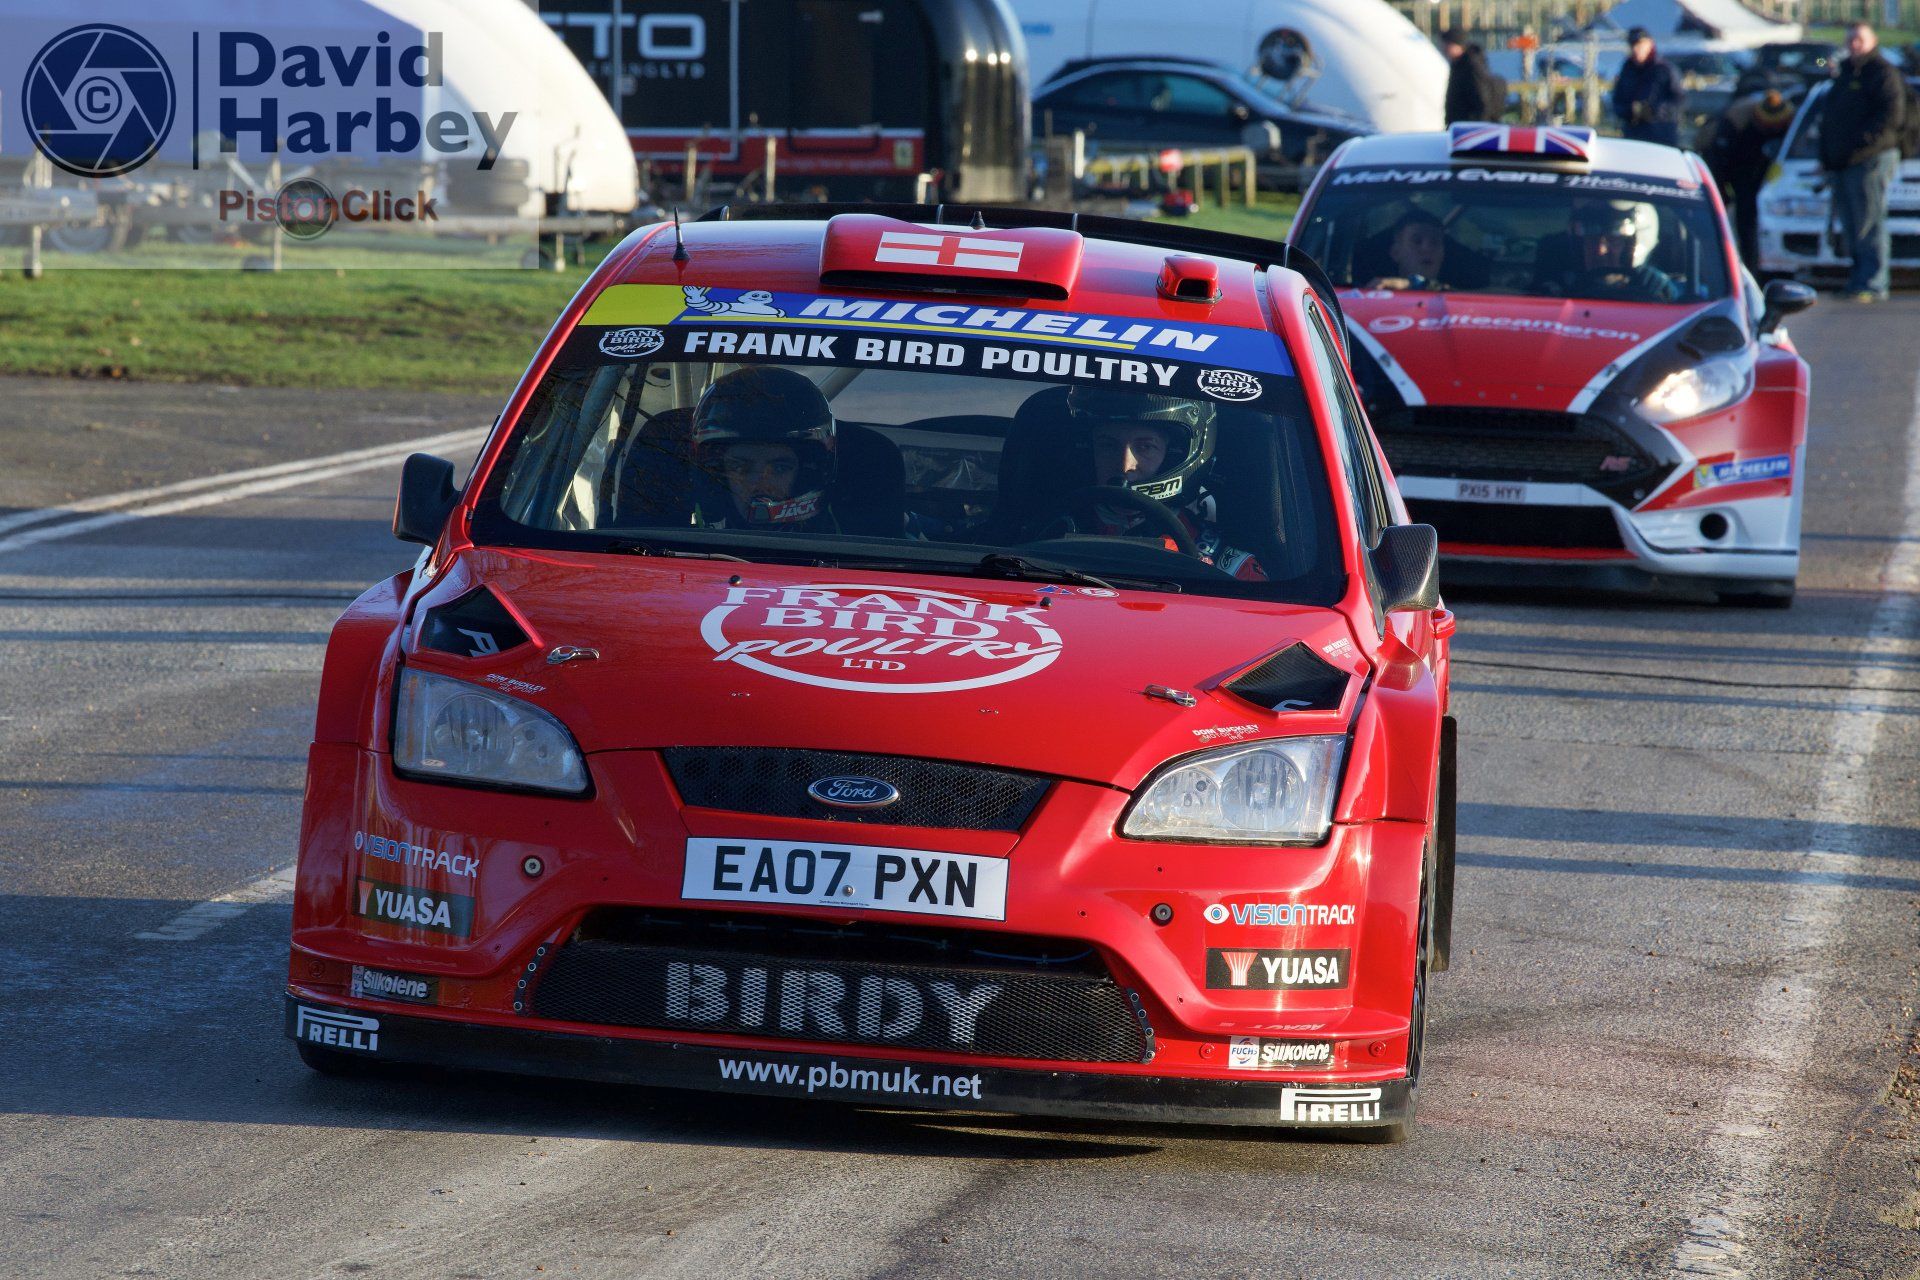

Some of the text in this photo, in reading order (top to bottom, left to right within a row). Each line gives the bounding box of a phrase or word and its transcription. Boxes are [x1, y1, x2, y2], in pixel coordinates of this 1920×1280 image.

[1332, 169, 1453, 185] Melvyn
[1457, 168, 1558, 184] Evans
[799, 299, 1219, 352] MICHELIN
[683, 331, 1180, 387] FRANK BIRD POULTRY
[1200, 369, 1259, 383] FRANK
[1208, 376, 1251, 389] BIRD
[1494, 485, 1524, 500] HYY
[721, 587, 1050, 627] FRANK
[761, 607, 999, 640] BIRD
[713, 637, 1063, 662] POULTRY
[842, 658, 906, 671] LTD
[1192, 723, 1259, 736] DOM BUCKLEY
[828, 779, 879, 800] Ford
[712, 845, 978, 908] EA07 PXN
[376, 888, 451, 929] YUASA
[363, 970, 427, 998] Silkolene
[1261, 956, 1339, 985] YUASA
[665, 961, 1003, 1044] BIRDY
[1231, 1047, 1258, 1055] FUCHS
[1261, 1042, 1330, 1063] Silkolene
[718, 1058, 982, 1100] www.pbmuk.net
[1280, 1087, 1382, 1122] PIRELLI
